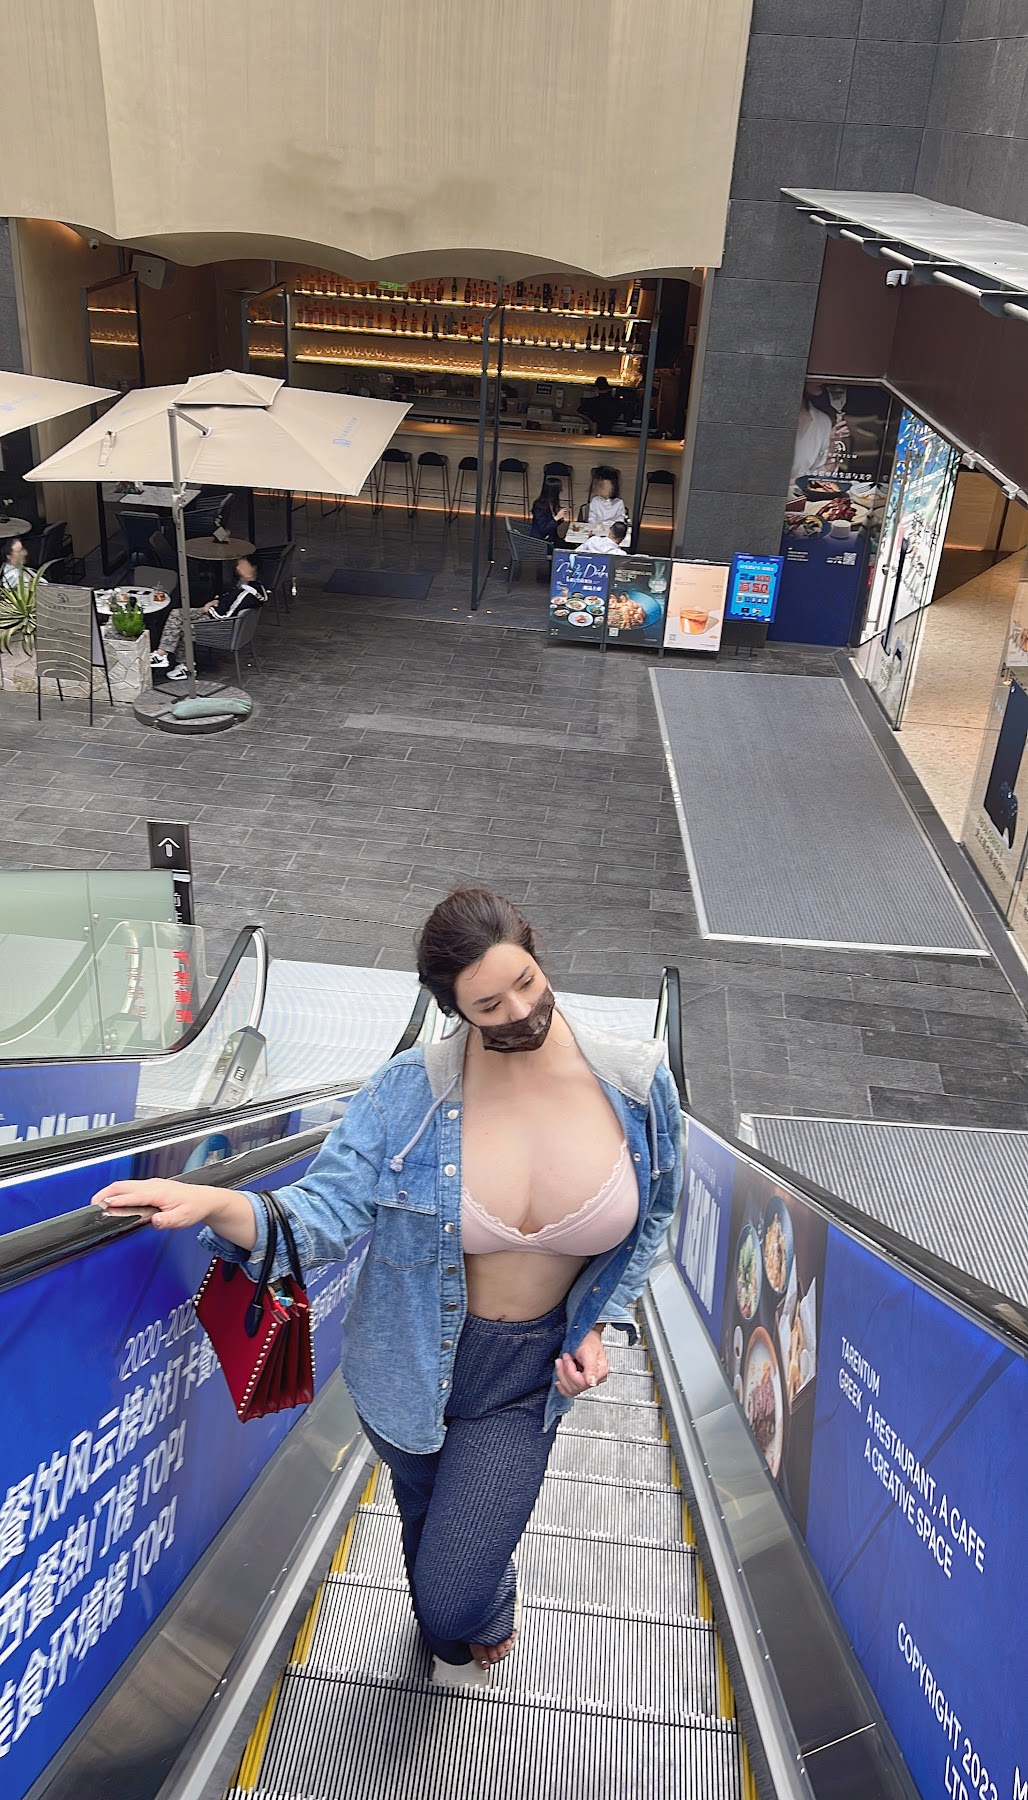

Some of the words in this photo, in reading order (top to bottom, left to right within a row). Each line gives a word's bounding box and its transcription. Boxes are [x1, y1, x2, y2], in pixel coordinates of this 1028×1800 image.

[119, 1294, 197, 1381] 2020-202
[841, 1336, 880, 1398] TARENTUM
[140, 1418, 188, 1507] TOP1
[838, 1367, 862, 1413] GREEK
[866, 1403, 874, 1429] A
[873, 1415, 938, 1516] RESTAURANT,
[939, 1494, 948, 1527] A
[950, 1507, 986, 1574] CAFE
[864, 1438, 871, 1464] A
[871, 1447, 916, 1526] CREATIVE
[916, 1506, 953, 1579] SPACE
[130, 1494, 179, 1591] TOP1
[897, 1621, 962, 1751] COPYRIGHT
